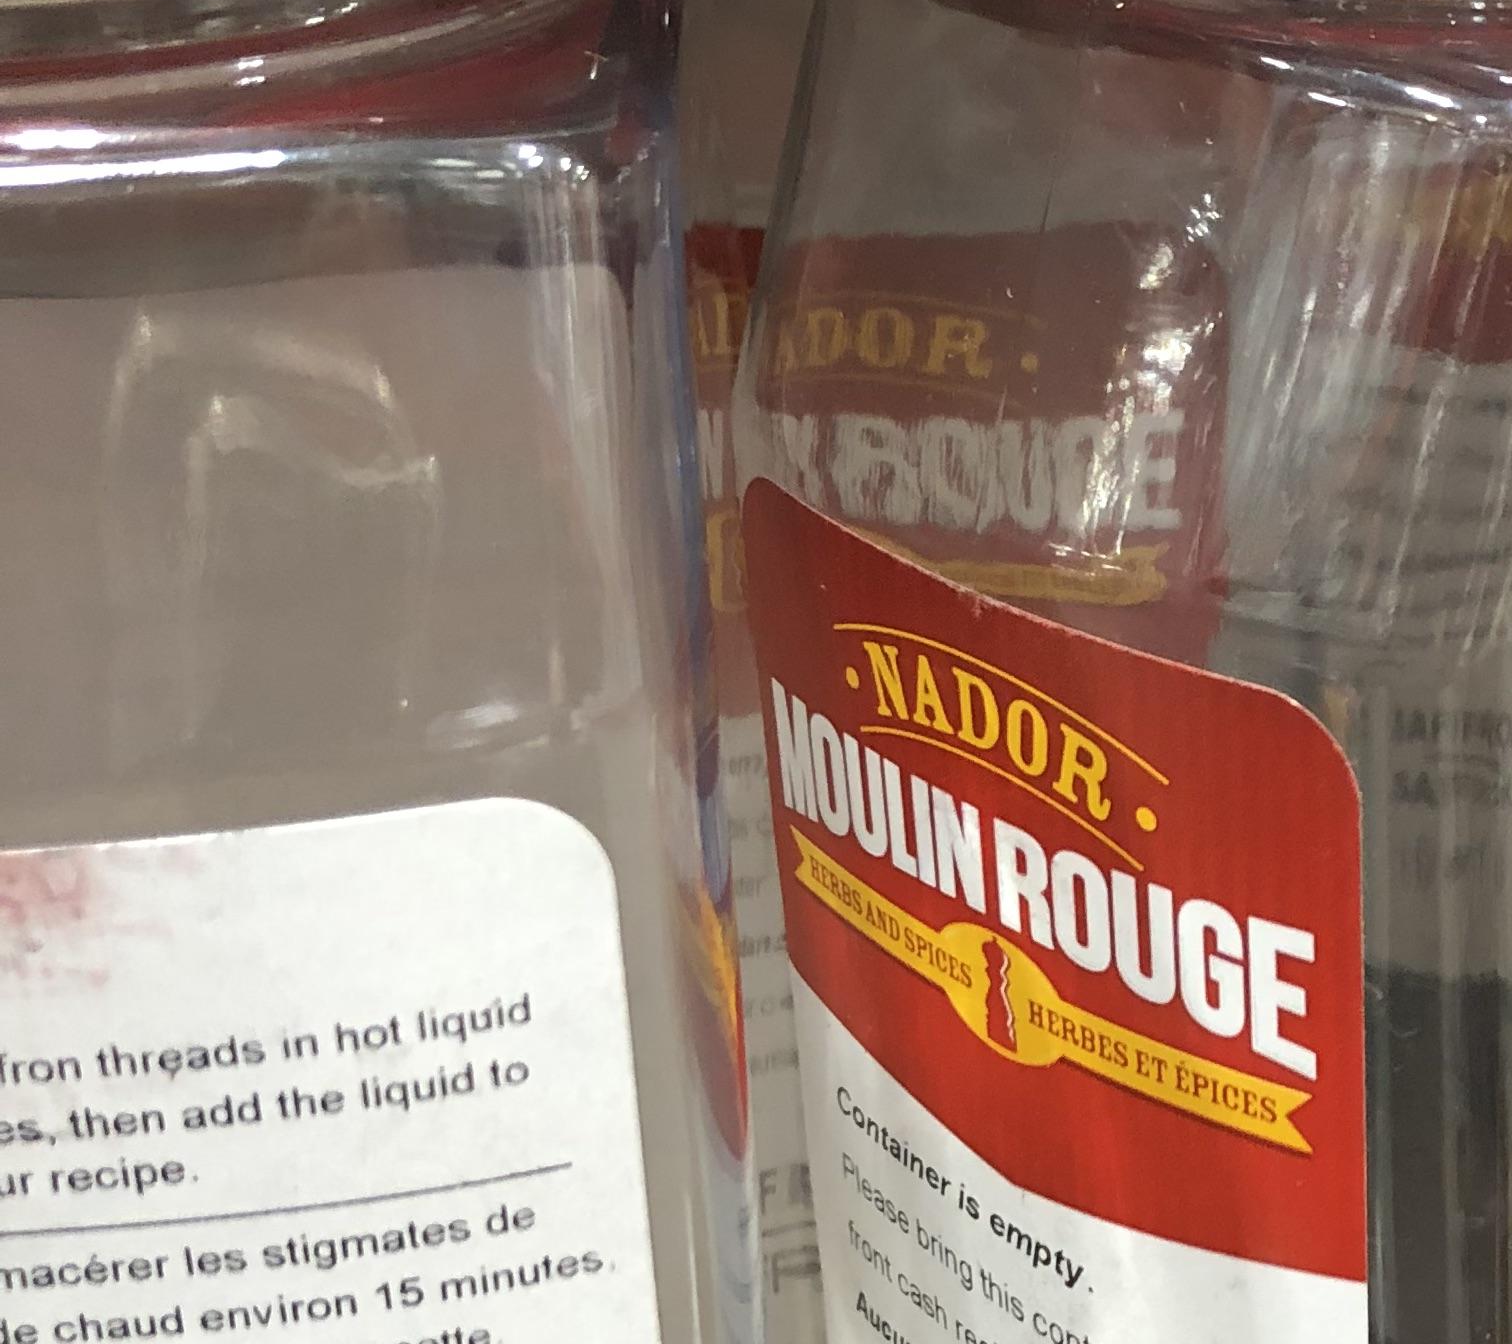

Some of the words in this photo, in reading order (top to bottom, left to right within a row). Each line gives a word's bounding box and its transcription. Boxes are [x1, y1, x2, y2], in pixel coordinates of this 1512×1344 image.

[863, 641, 1112, 821] NADOR
[771, 677, 987, 915] MOULIN
[993, 817, 1317, 1081] ROUGE
[809, 856, 863, 916] HERBS
[865, 897, 901, 943] AND
[904, 926, 973, 990] SPICES
[96, 1035, 266, 1080] threads
[283, 1035, 319, 1059] in
[335, 1016, 401, 1053] hot
[417, 993, 531, 1044] liquid
[1028, 999, 1130, 1071] HERBES
[1134, 1049, 1168, 1084] ET
[1176, 1059, 1279, 1126] ÉPICES
[69, 1107, 165, 1139] then
[183, 1092, 262, 1129] add
[277, 1087, 344, 1120] the
[361, 1062, 475, 1111] liquid
[490, 1060, 529, 1089] to
[50, 1158, 198, 1195] recipe.
[837, 1087, 951, 1201] Container
[959, 1183, 979, 1220] is
[990, 1214, 1093, 1292] empty.
[842, 1148, 909, 1236] Please
[916, 1219, 973, 1291] bring
[980, 1268, 1024, 1322] this
[184, 1246, 247, 1276] les
[263, 1220, 471, 1270] stigmates
[486, 1204, 535, 1235] de
[848, 1220, 892, 1283] front
[898, 1273, 947, 1329] cash
[54, 1305, 184, 1343] chaud
[200, 1295, 357, 1332] environ
[376, 1277, 424, 1310] 15
